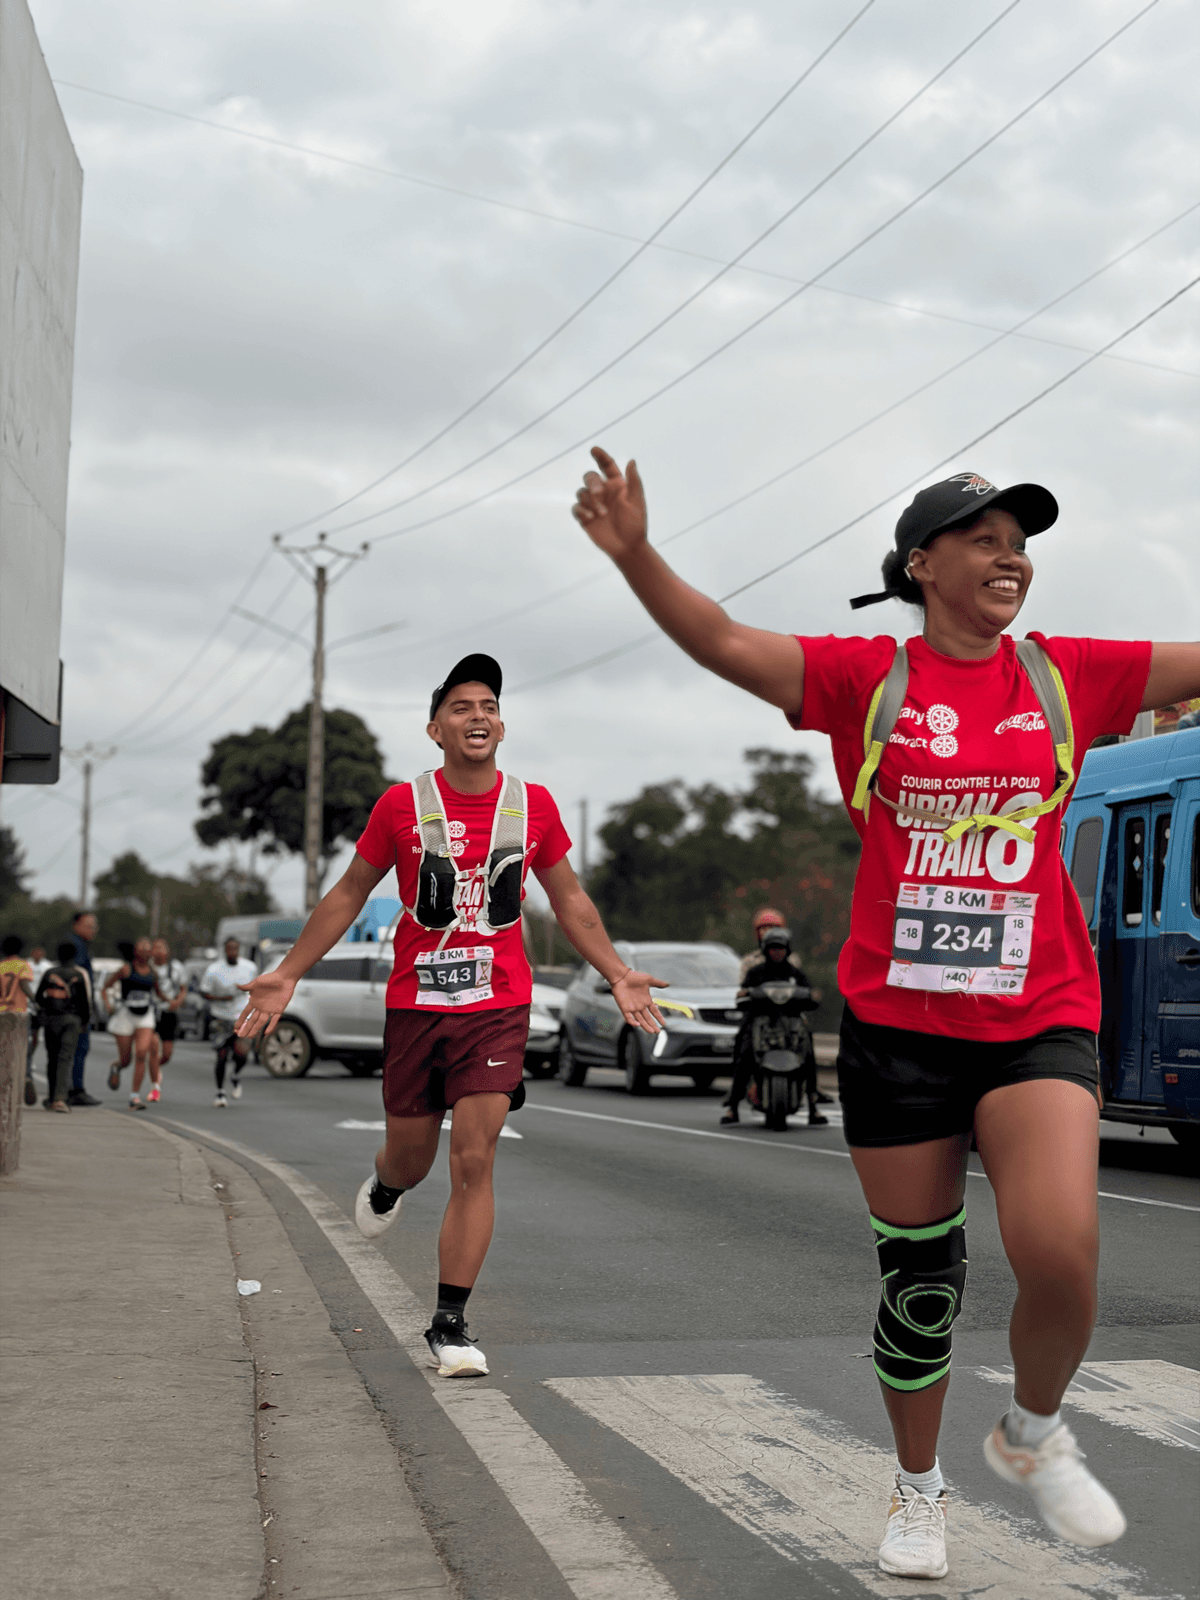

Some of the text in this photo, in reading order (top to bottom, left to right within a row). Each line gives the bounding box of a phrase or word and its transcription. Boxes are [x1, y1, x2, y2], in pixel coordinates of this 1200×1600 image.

[901, 774, 1040, 790] COURIR CONTRE LA POLIO
[896, 790, 999, 830] URBAN
[904, 831, 985, 877] TRAIL
[944, 890, 954, 905] 8
[958, 892, 986, 908] KM
[1013, 919, 1024, 929] 18
[901, 927, 918, 939] -18
[931, 923, 993, 952] 234
[439, 951, 446, 960] 8
[448, 950, 464, 960] KM
[1008, 949, 1023, 958] 40
[437, 967, 471, 985] 543
